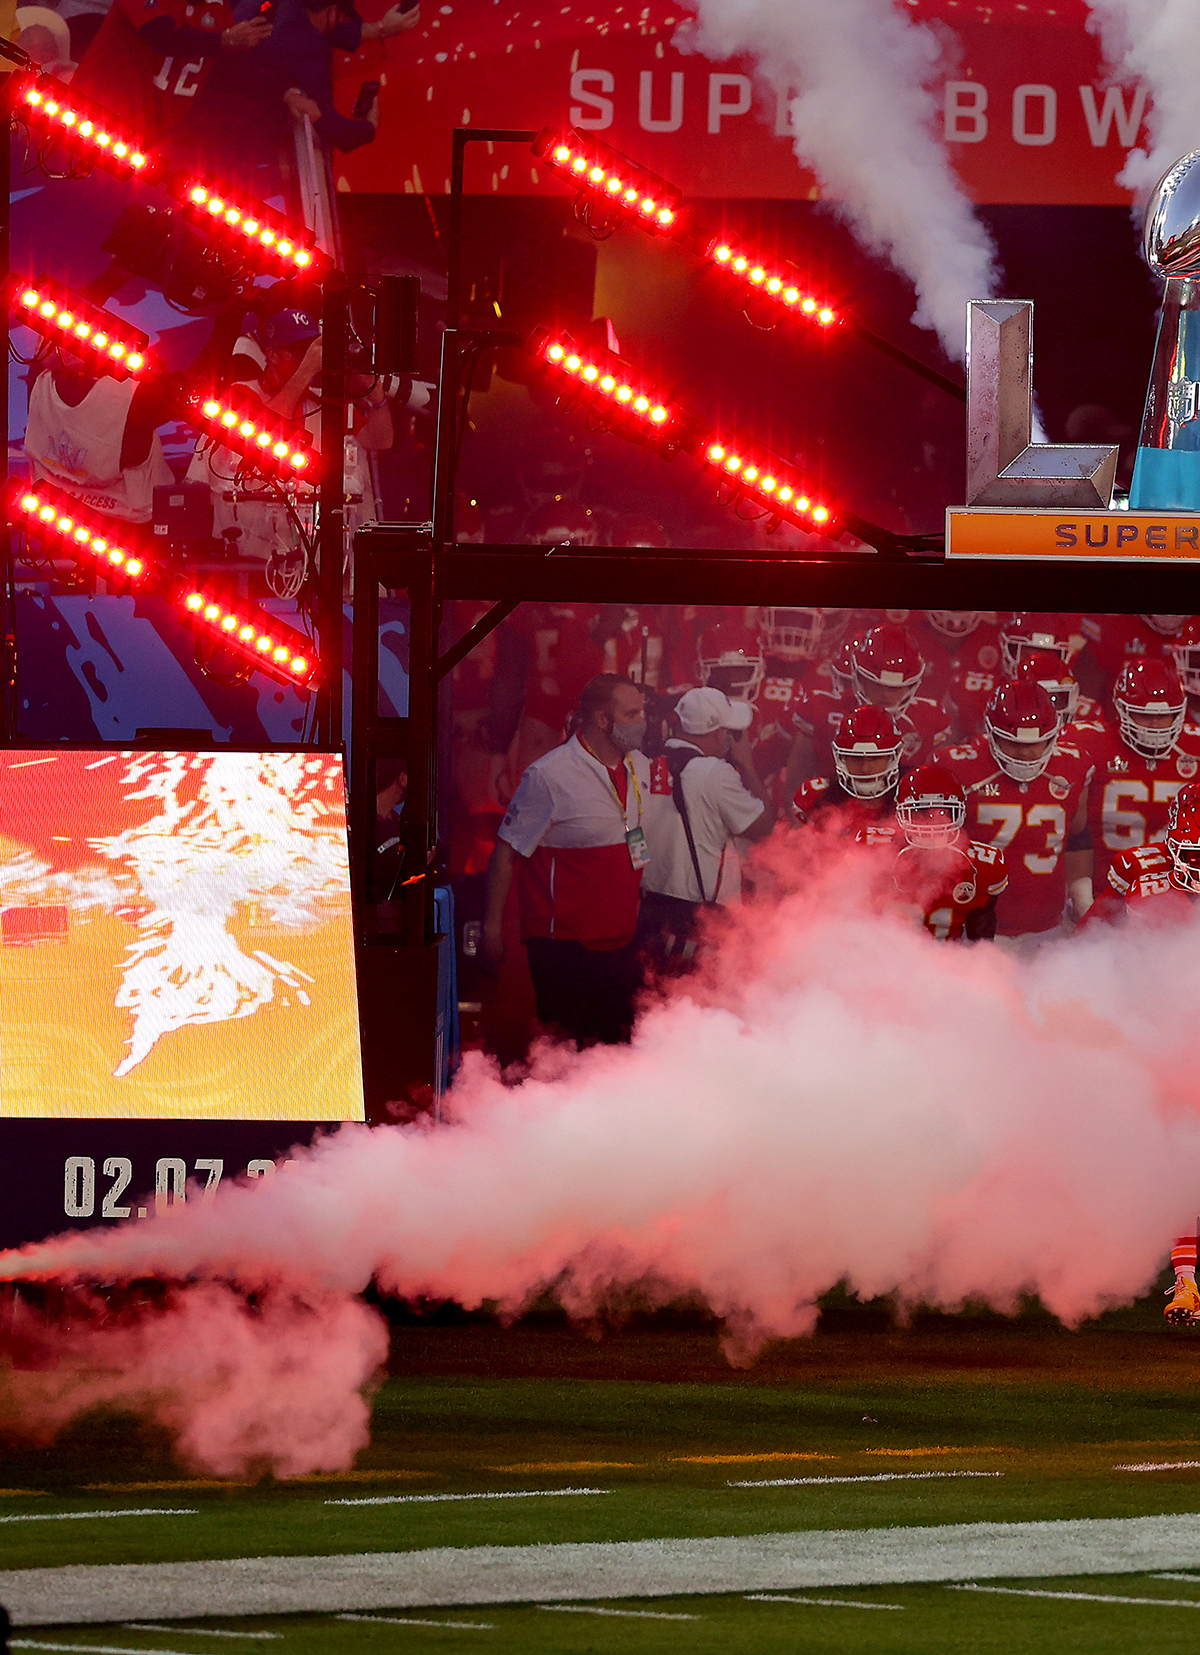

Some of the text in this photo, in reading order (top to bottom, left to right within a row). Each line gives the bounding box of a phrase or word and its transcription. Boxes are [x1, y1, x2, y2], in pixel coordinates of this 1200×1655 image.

[569, 69, 795, 137] SUP
[945, 81, 1151, 147] BOW
[292, 312, 309, 326] KC
[1055, 523, 1200, 550] SUPER
[977, 803, 1066, 875] 73
